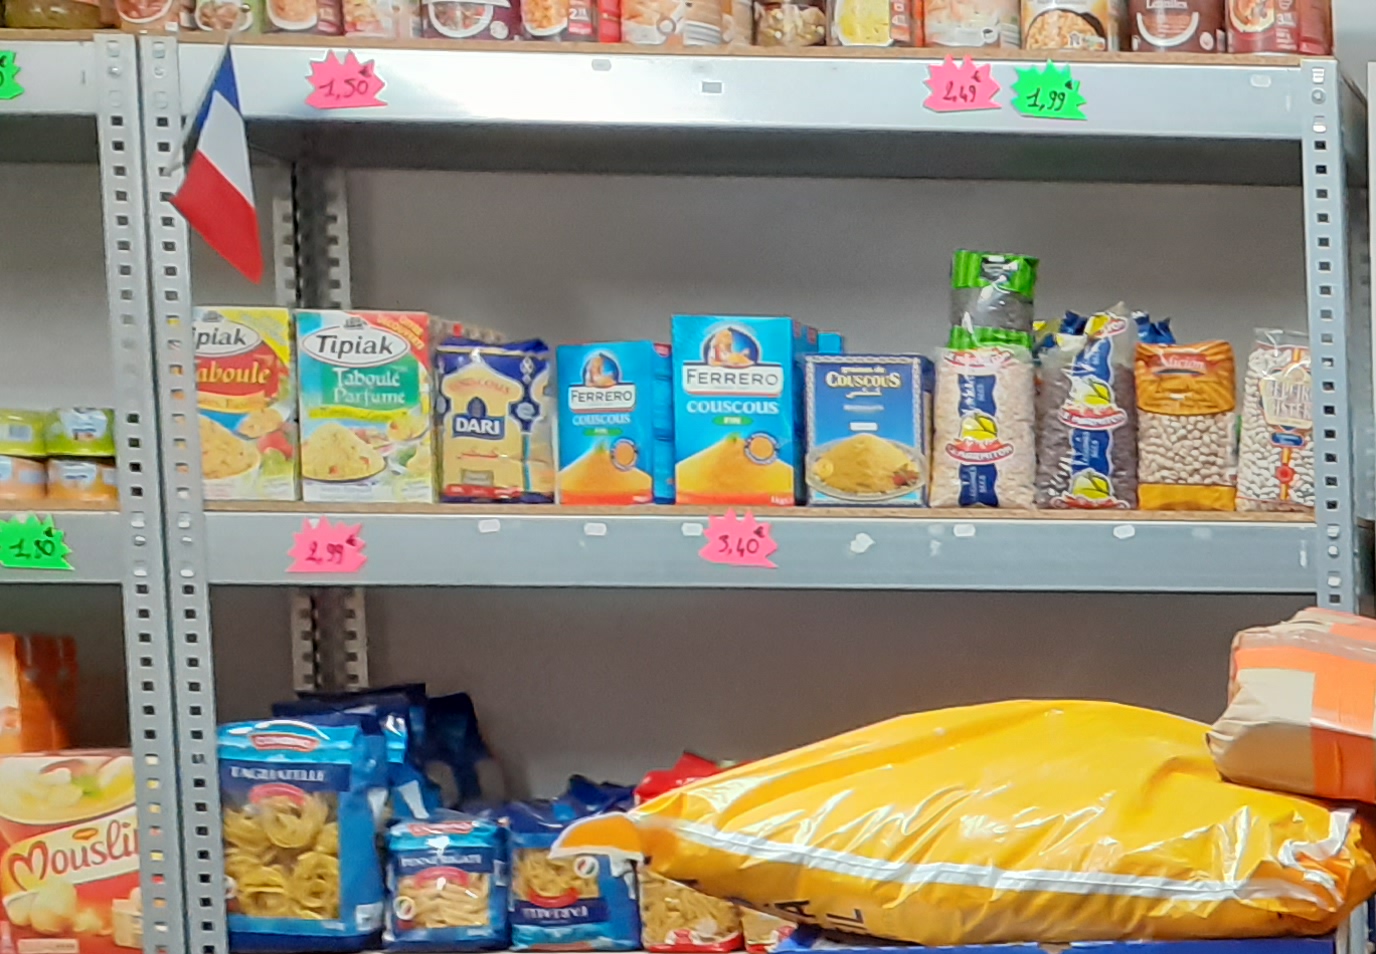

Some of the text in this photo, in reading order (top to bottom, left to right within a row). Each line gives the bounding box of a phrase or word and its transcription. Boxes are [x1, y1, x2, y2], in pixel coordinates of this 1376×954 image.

[191, 327, 247, 349] ipiak
[316, 334, 394, 359] Tipiak
[686, 368, 779, 386] FERRERO
[571, 389, 633, 403] FERRERO
[455, 417, 501, 436] DARI
